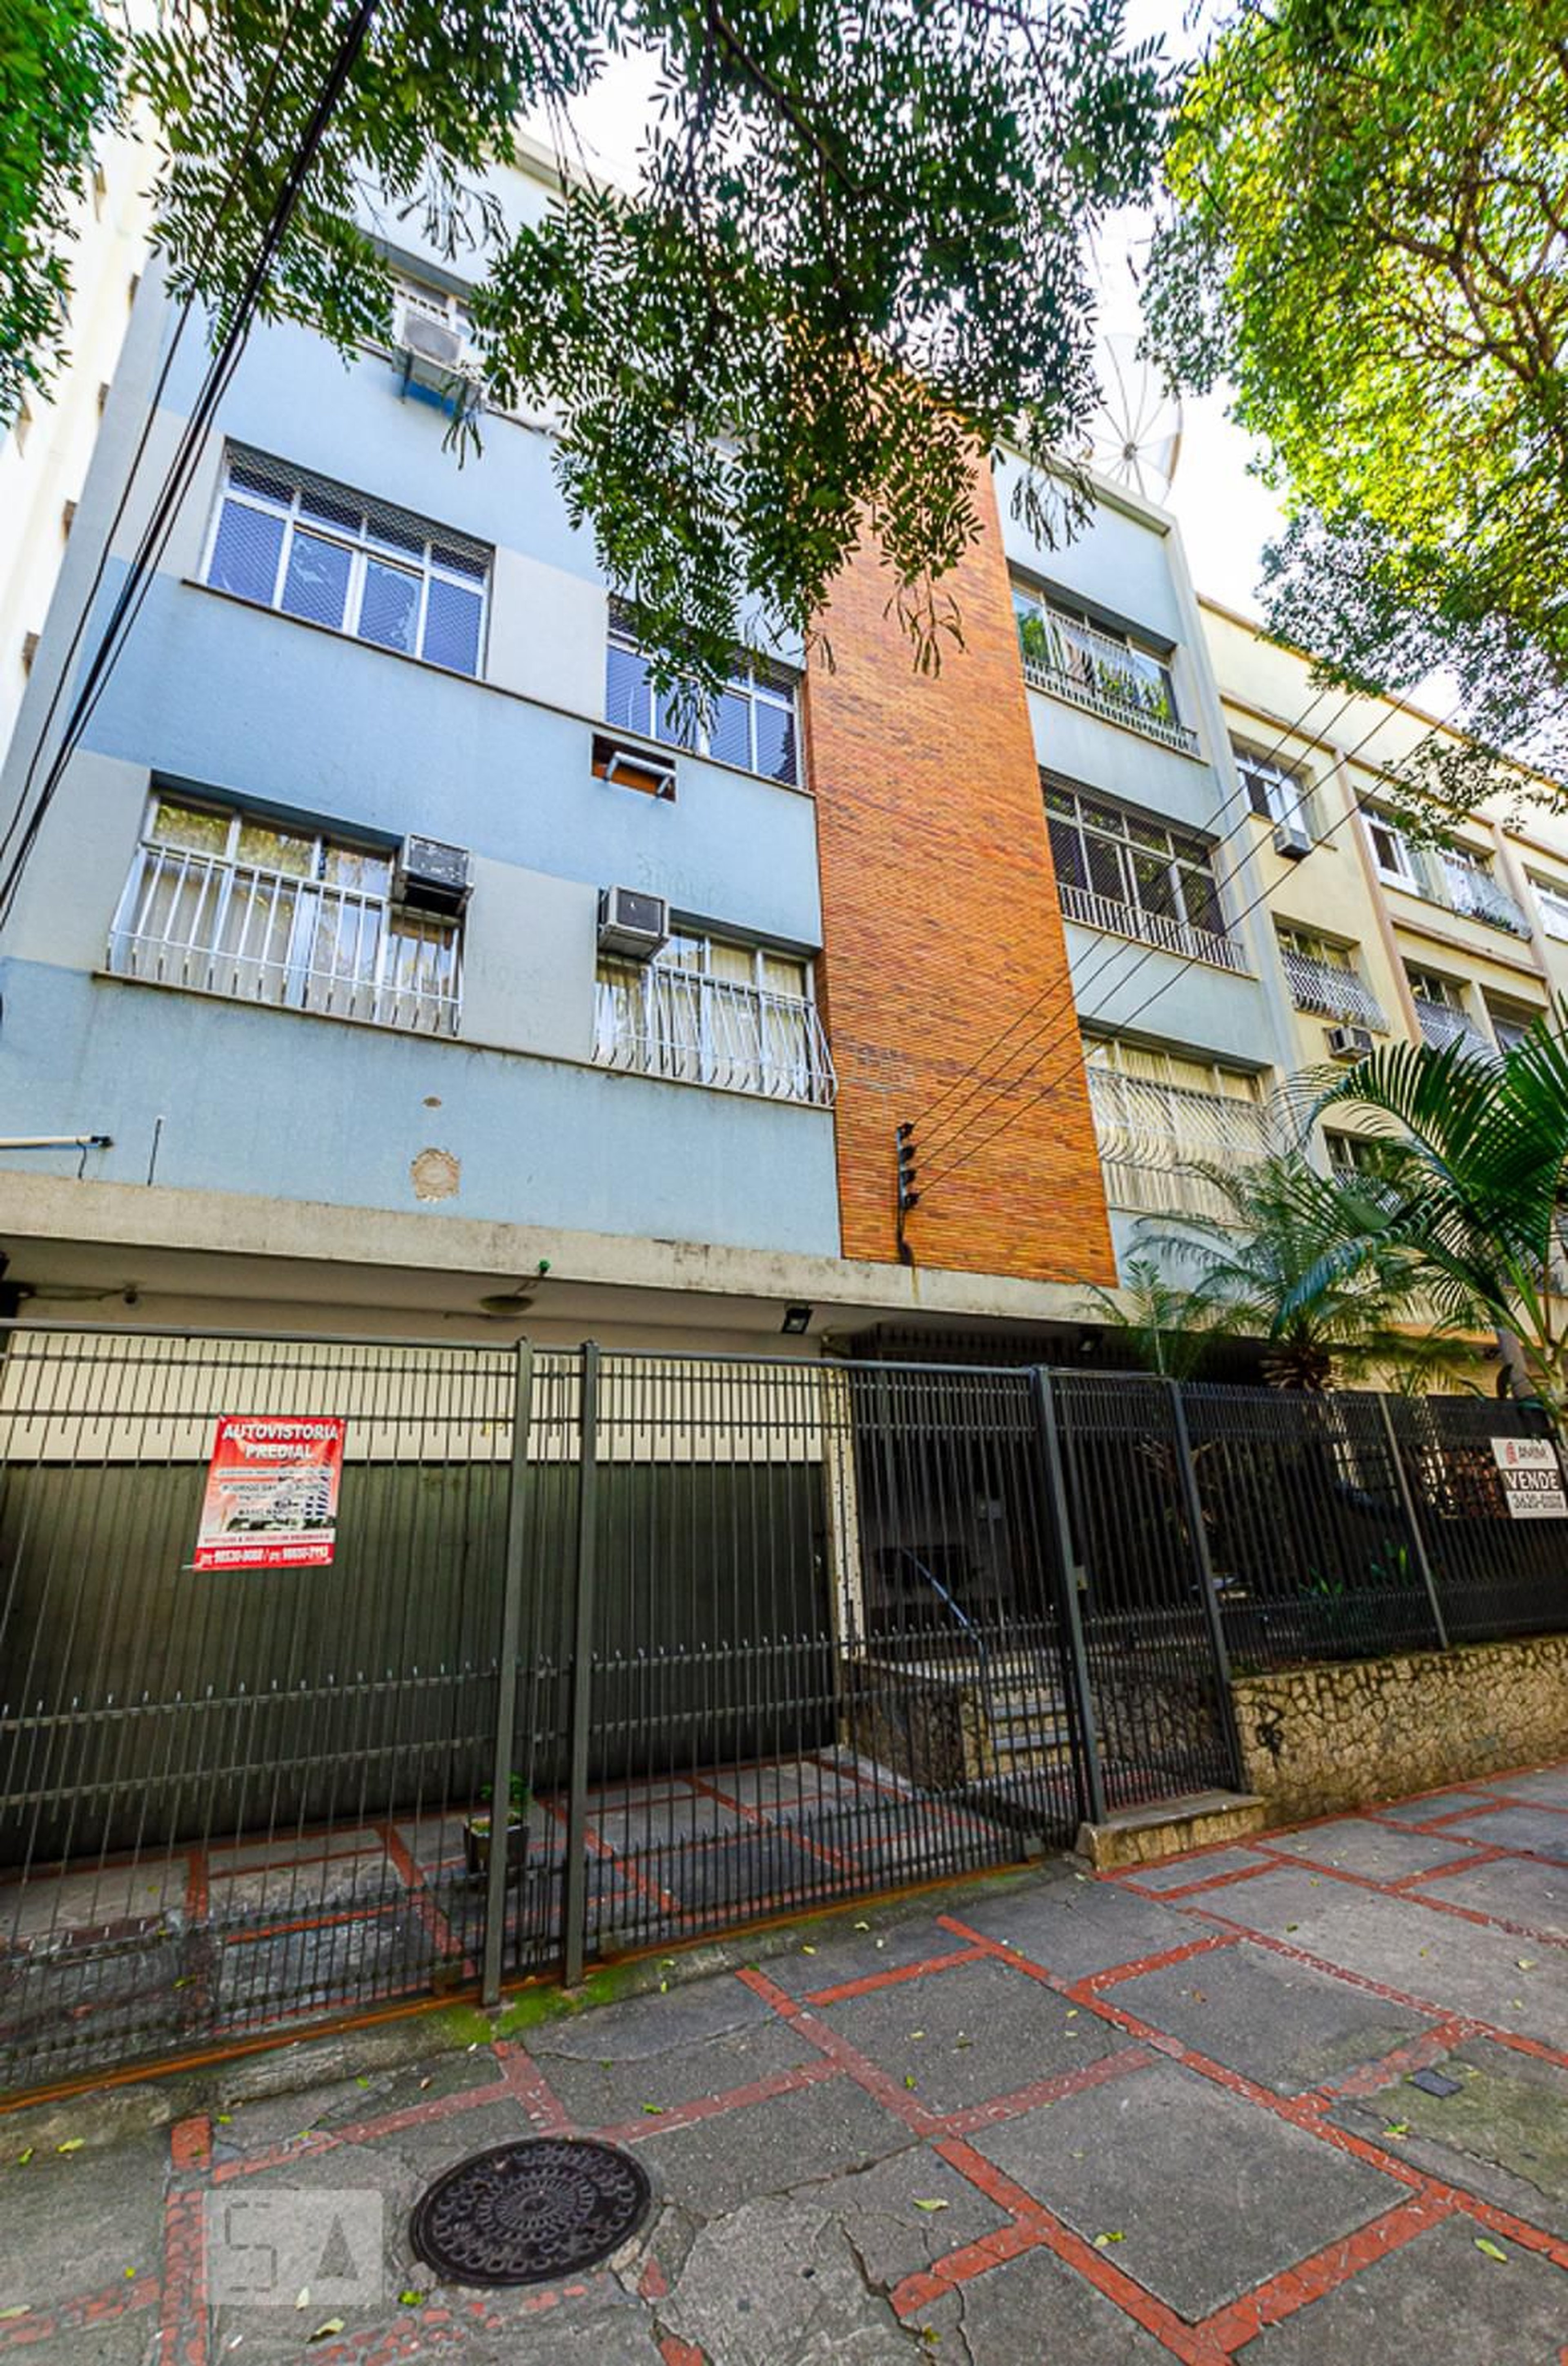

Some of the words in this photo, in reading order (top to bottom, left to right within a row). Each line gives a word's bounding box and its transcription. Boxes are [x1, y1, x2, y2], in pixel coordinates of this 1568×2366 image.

[222, 1423, 339, 1440] AUTOVISTORIA
[245, 1443, 314, 1459] PREDIAL
[1504, 1470, 1560, 1490] VENDE
